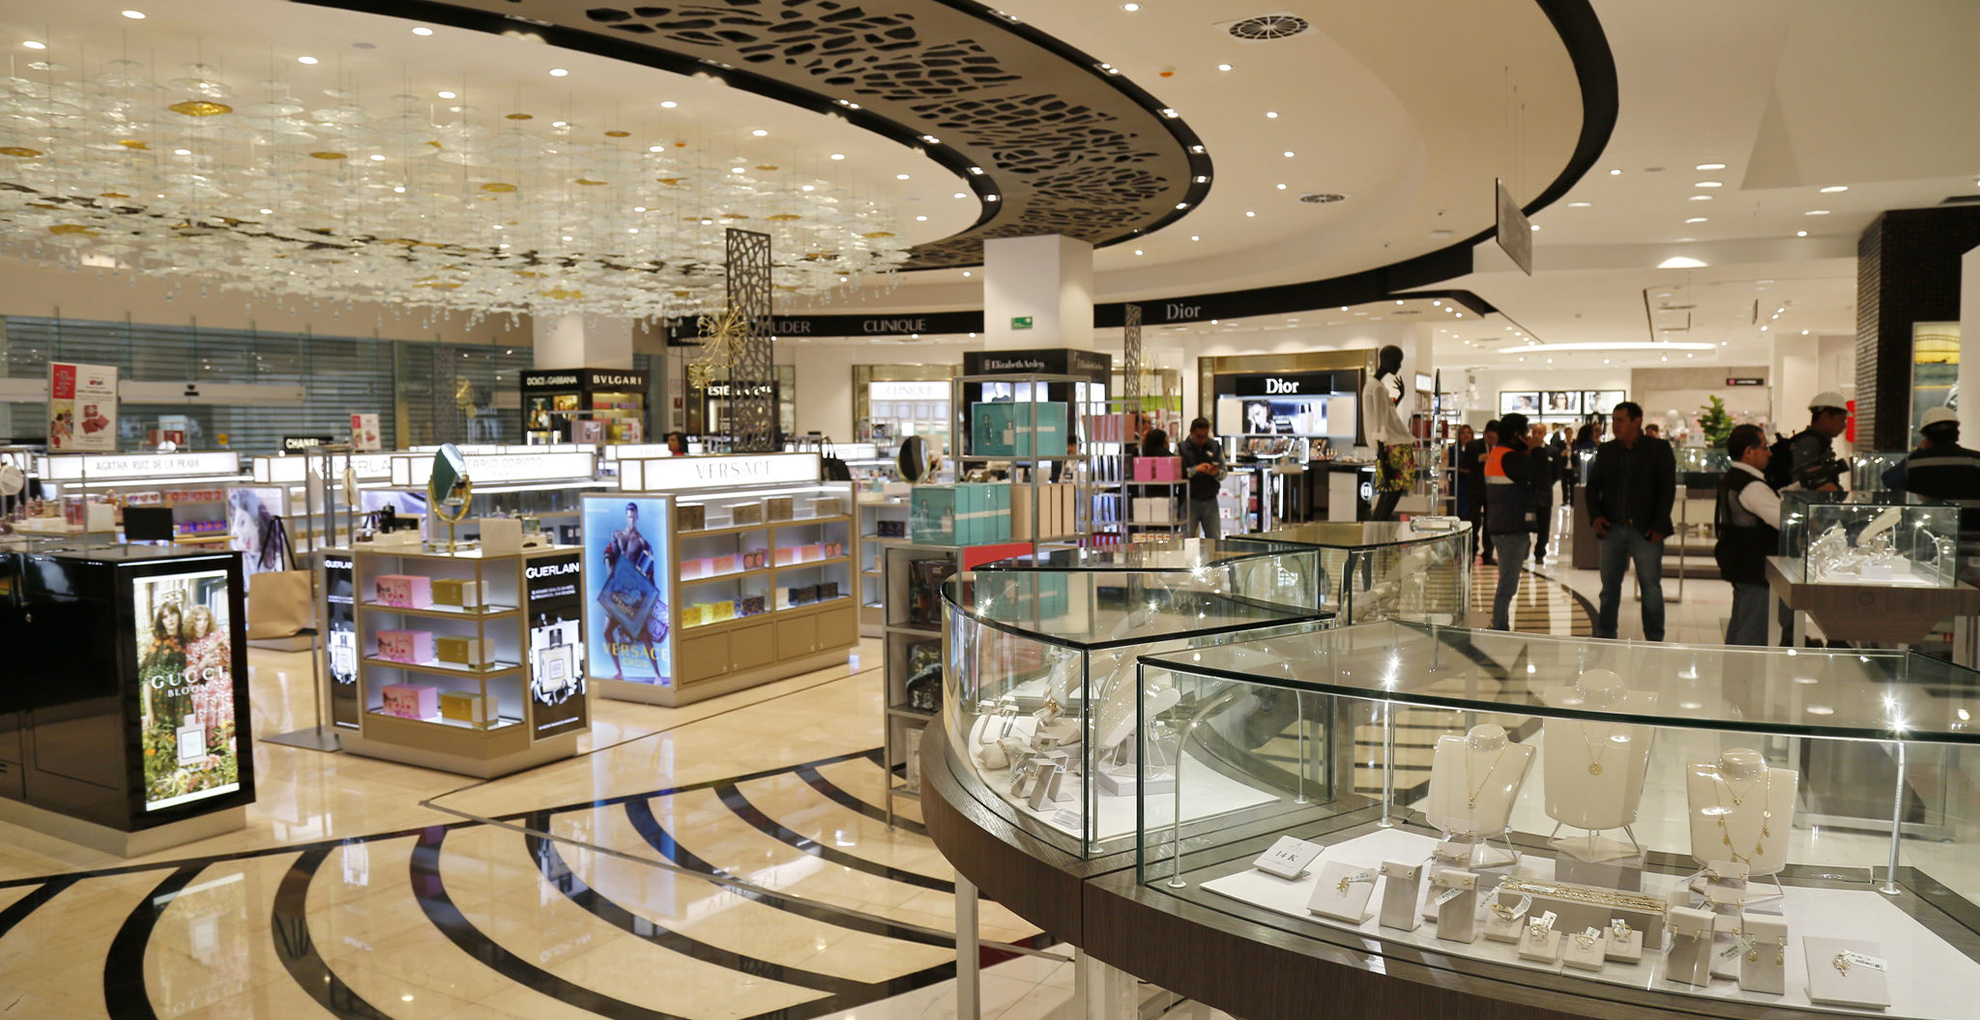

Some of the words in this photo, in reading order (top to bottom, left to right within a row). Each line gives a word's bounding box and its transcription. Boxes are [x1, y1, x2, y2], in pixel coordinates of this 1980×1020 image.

[1166, 303, 1201, 320] Dior
[863, 318, 927, 334] CLINIQUE
[991, 359, 1024, 369] Elizabeth
[1024, 359, 1045, 369] Arden
[592, 374, 642, 385] BVLGARI
[1265, 378, 1300, 394] Dior
[96, 460, 128, 471] AGATHA
[132, 460, 149, 470] RUIZ
[153, 459, 162, 469] DE
[165, 459, 174, 469] LA
[176, 458, 200, 468] PRADA
[695, 461, 773, 479] VERSACE
[525, 562, 580, 579] GUERLAIN
[603, 642, 669, 662] VERSACE
[151, 665, 224, 690] GUCCI
